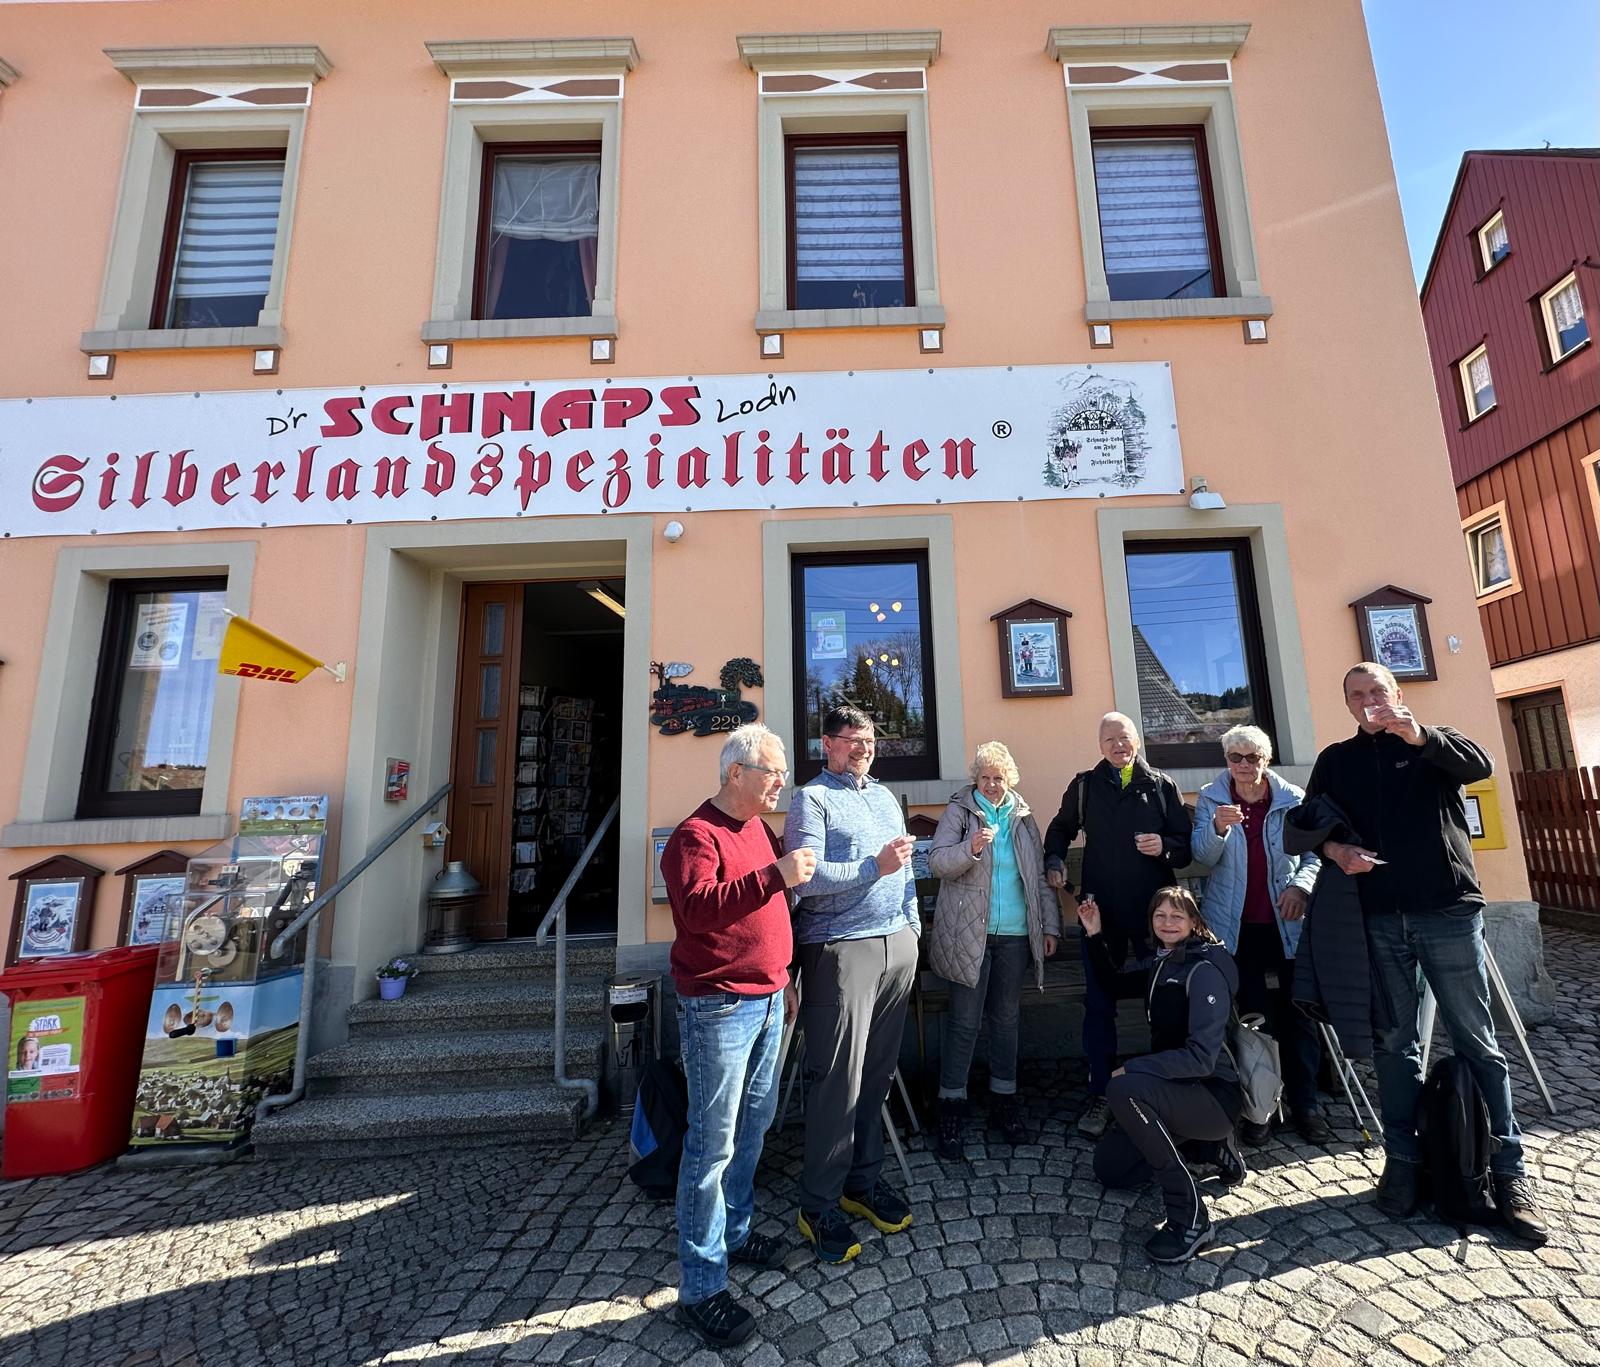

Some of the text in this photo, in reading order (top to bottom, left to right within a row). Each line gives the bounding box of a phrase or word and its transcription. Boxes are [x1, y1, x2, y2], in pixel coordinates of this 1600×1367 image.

[321, 385, 701, 441] SCHNAPS
[717, 383, 797, 424] Lodn
[32, 428, 979, 512] Silberlandspezialitäten
[237, 663, 297, 684] DHL
[711, 716, 741, 730] 229
